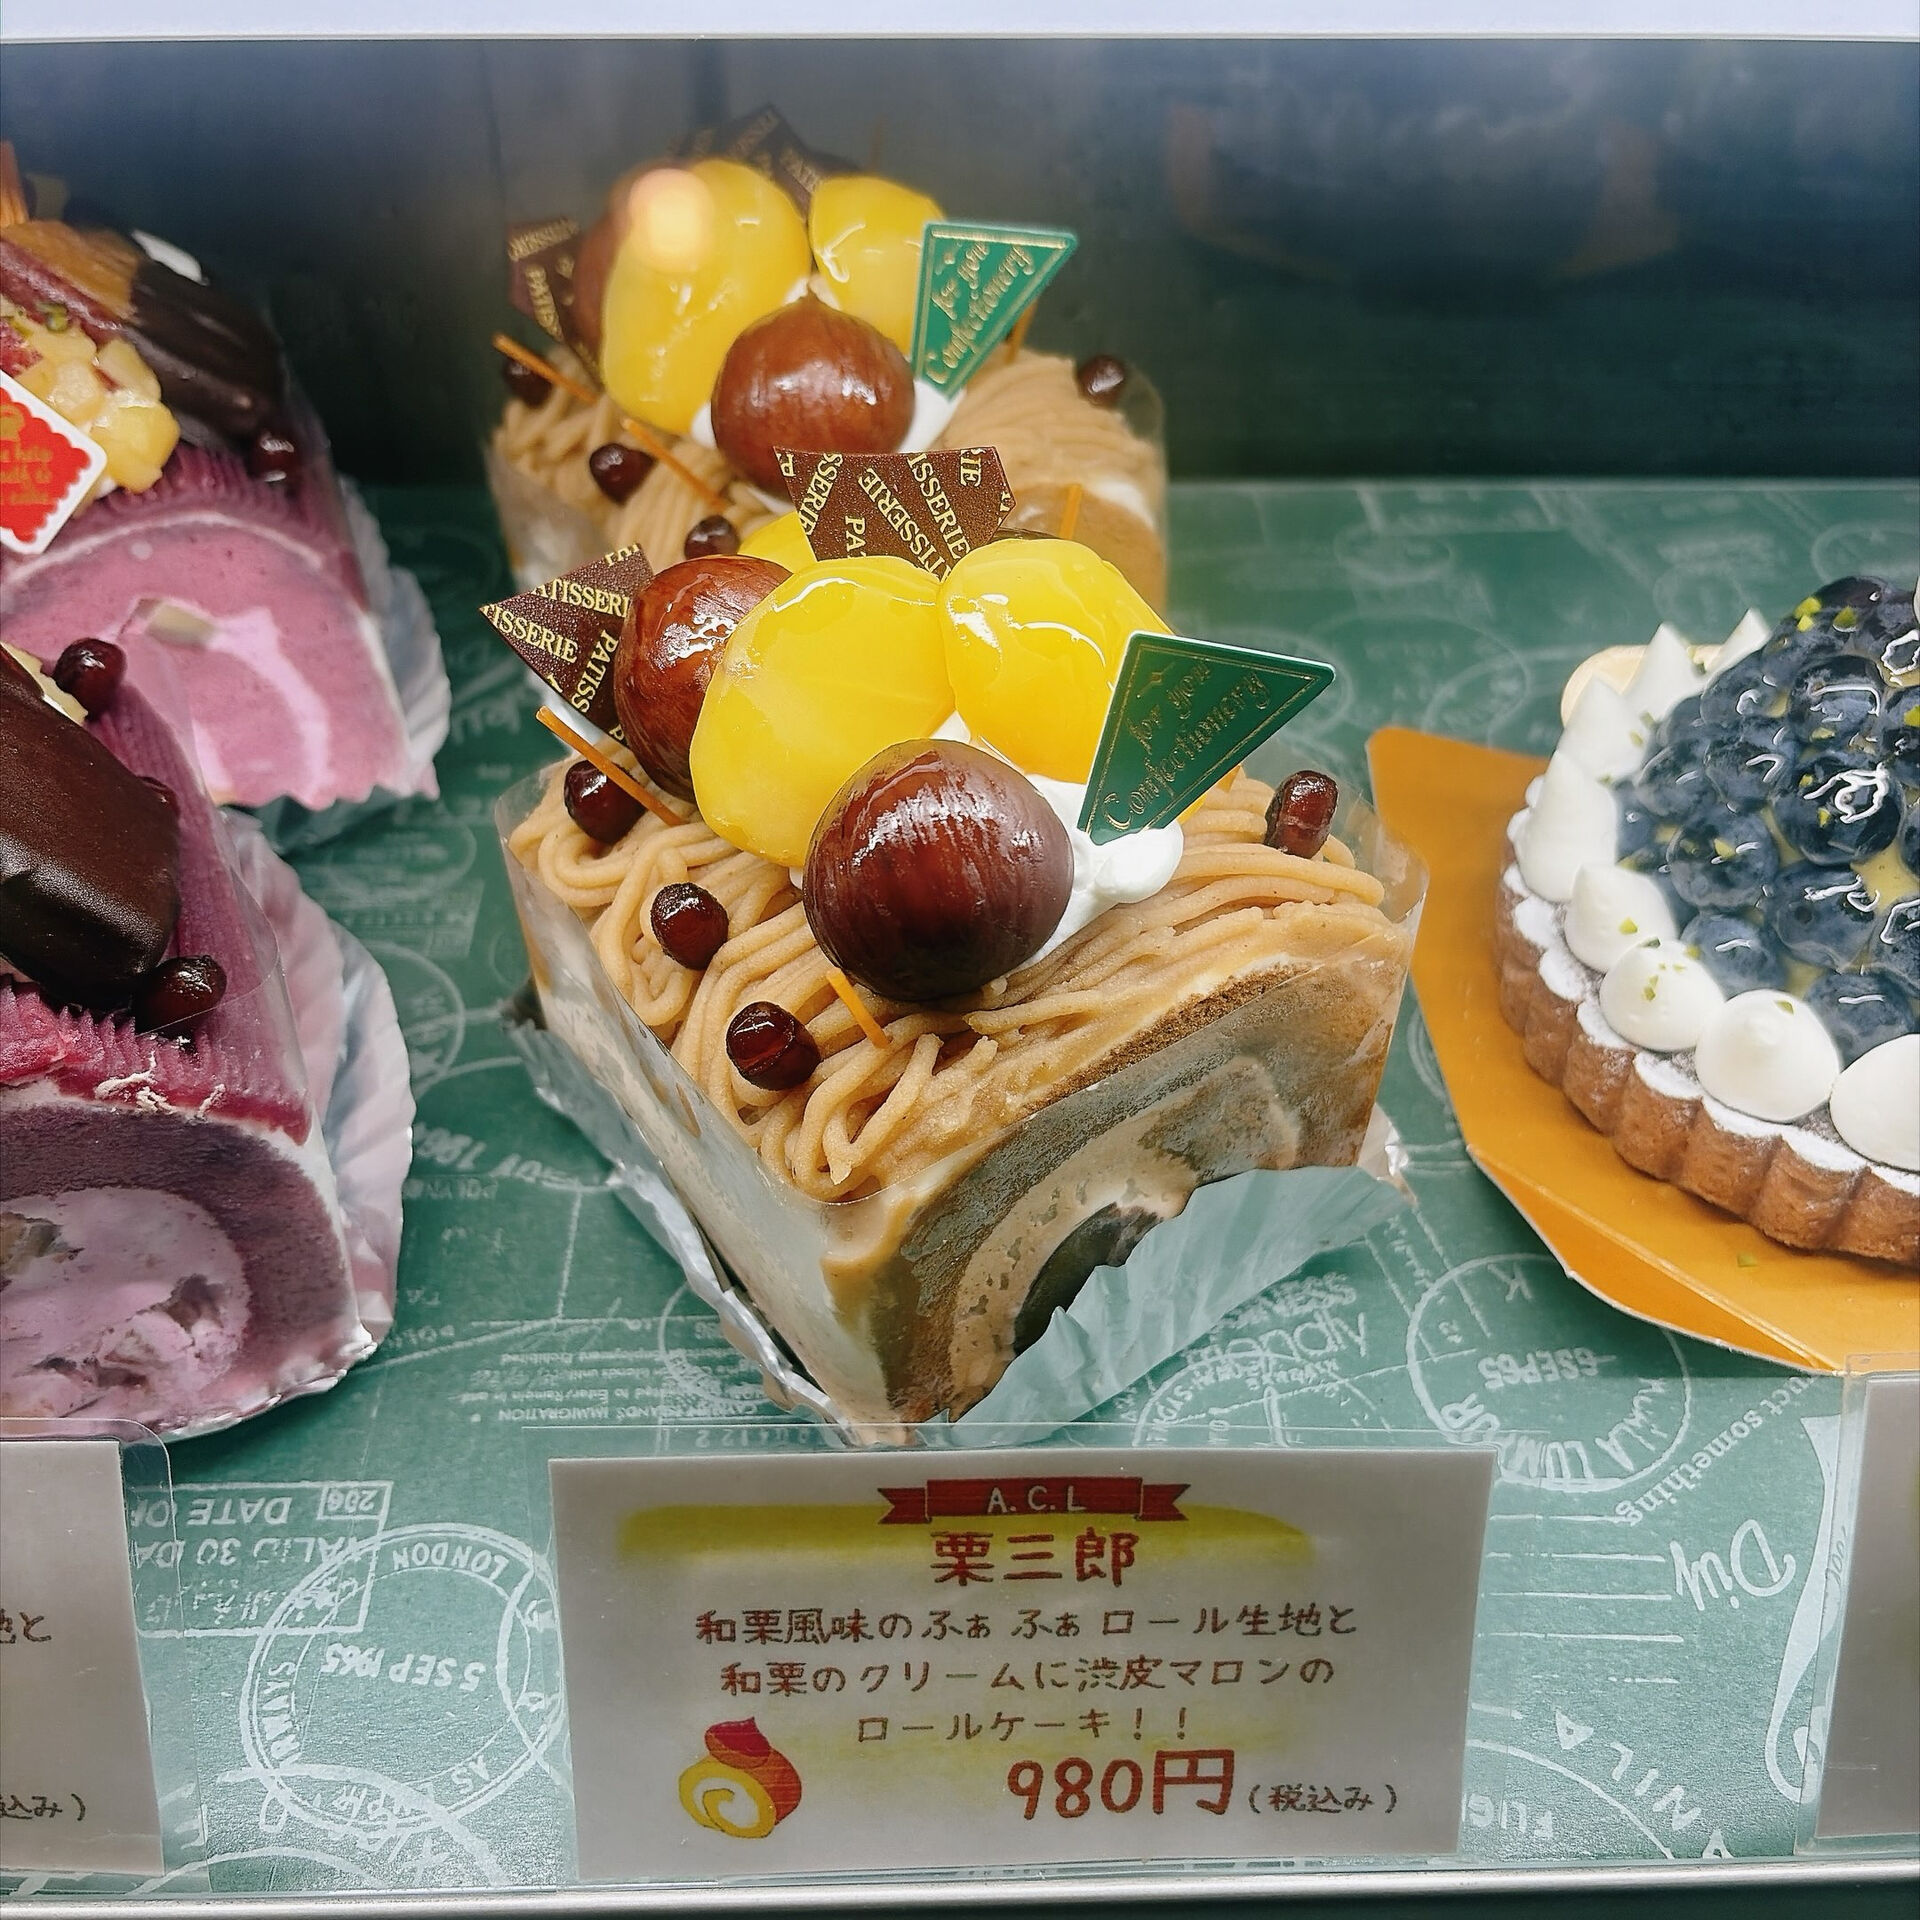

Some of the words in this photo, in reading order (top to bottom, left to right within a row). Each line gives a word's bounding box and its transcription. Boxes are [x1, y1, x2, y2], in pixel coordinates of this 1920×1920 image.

[1615, 1409, 1753, 1527] something
[186, 1496, 293, 1526] DATE
[196, 1537, 242, 1568] 30
[390, 1540, 511, 1583] LONDON
[929, 1526, 1140, 1588] 栗三郎
[720, 1653, 1335, 1697] 和栗のクリームに渋皮マロンの
[1007, 1748, 1235, 1821] 980円
